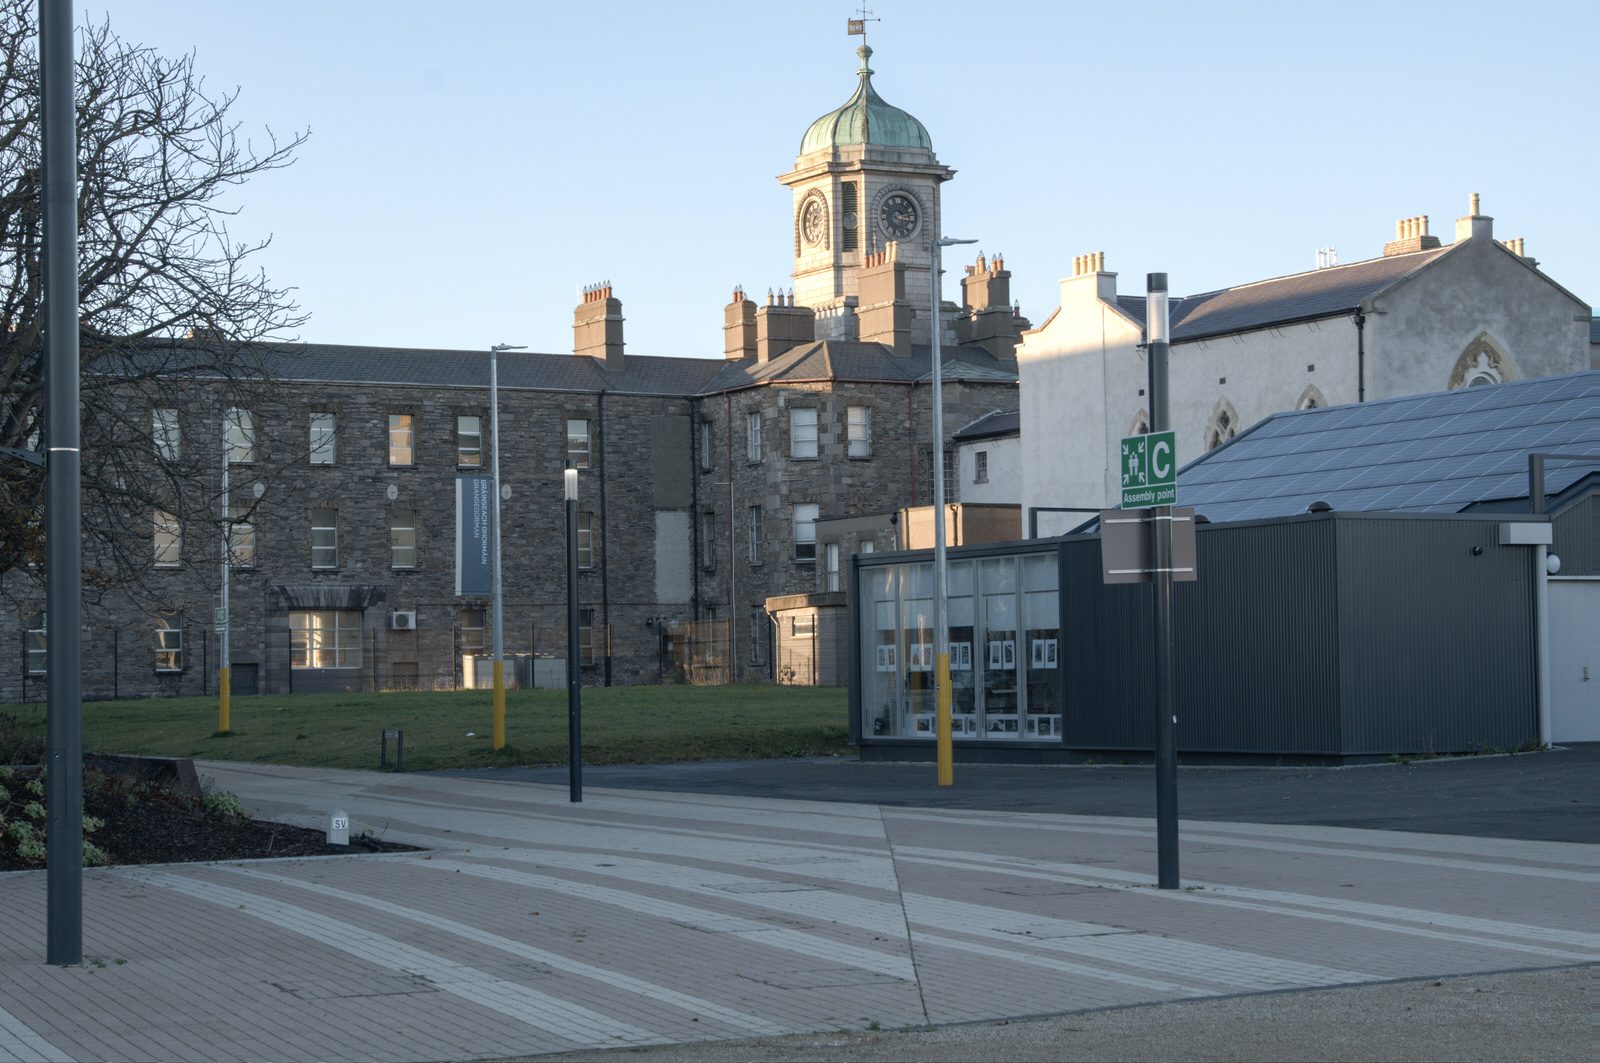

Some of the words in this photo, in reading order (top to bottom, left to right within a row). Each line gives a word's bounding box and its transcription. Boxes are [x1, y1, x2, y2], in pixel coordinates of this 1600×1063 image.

[1152, 441, 1170, 478] C
[480, 479, 488, 525] GRÁINSEACH
[1124, 490, 1155, 503] Assembly
[1158, 488, 1174, 502] point
[335, 819, 346, 828] SV
